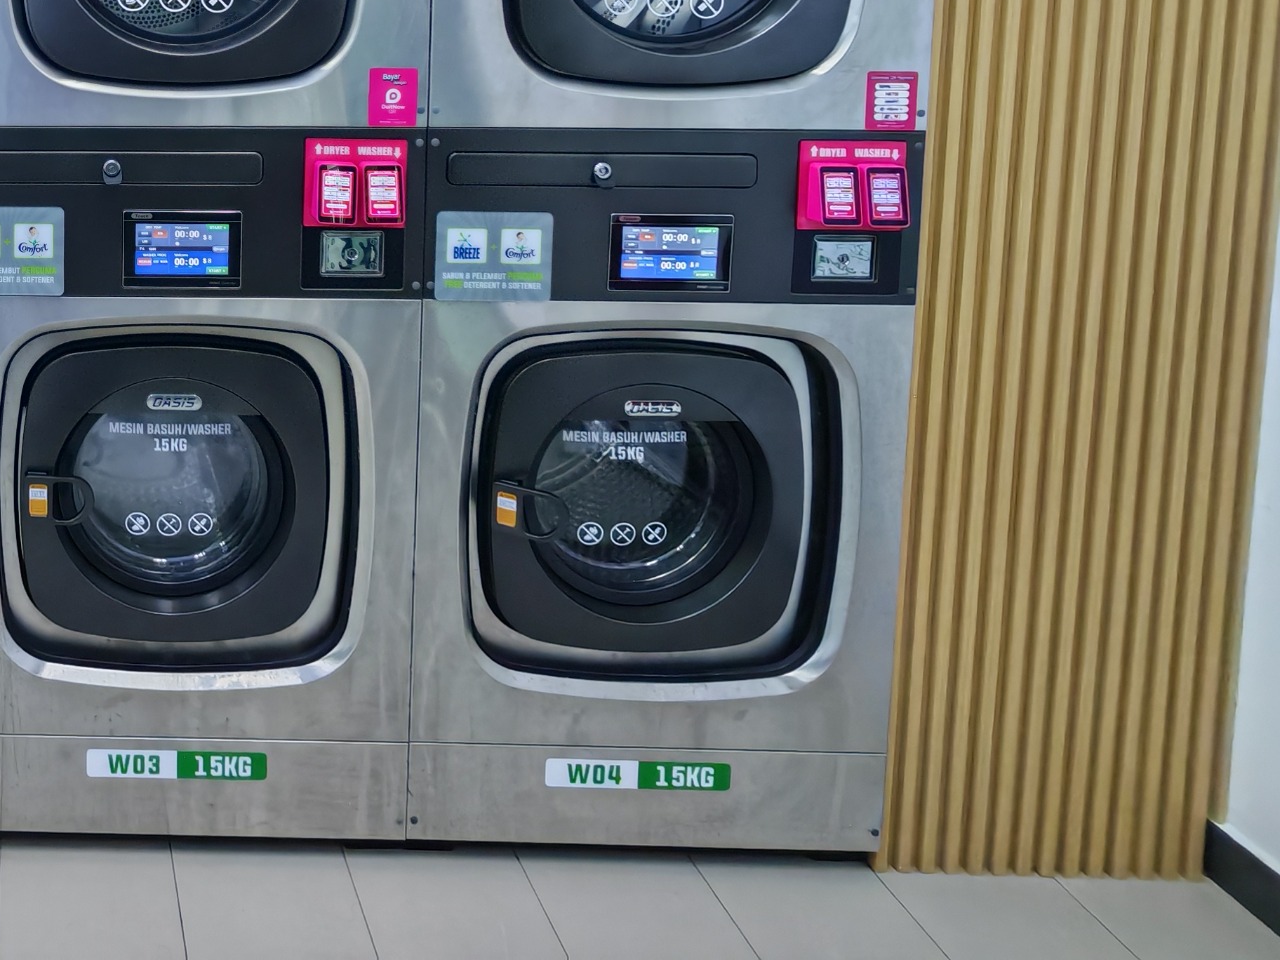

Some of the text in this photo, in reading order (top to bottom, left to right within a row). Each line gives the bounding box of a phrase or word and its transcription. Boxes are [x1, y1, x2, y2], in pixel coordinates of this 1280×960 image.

[323, 146, 393, 156] DRYER WASHER
[819, 148, 891, 158] DRYER WASHER
[174, 230, 200, 238] 00:00
[662, 233, 689, 242] 00:00
[18, 242, 49, 256] Comfort
[453, 246, 480, 260] BREEZE
[505, 247, 536, 262] Comfort
[174, 258, 200, 266] 00:00
[660, 262, 687, 270] 00:00
[22, 276, 55, 284] SOFTENER
[471, 272, 507, 280] PELEMBUT
[508, 282, 541, 290] SOFTENER
[109, 422, 231, 435] MESIN BASUH/WASHER
[562, 430, 687, 443] MESIN BASUH/WASHER
[153, 438, 188, 452] 15KG
[609, 446, 645, 460] 15KG
[107, 754, 252, 778] W03 15KG
[567, 763, 715, 788] W04 15KG
